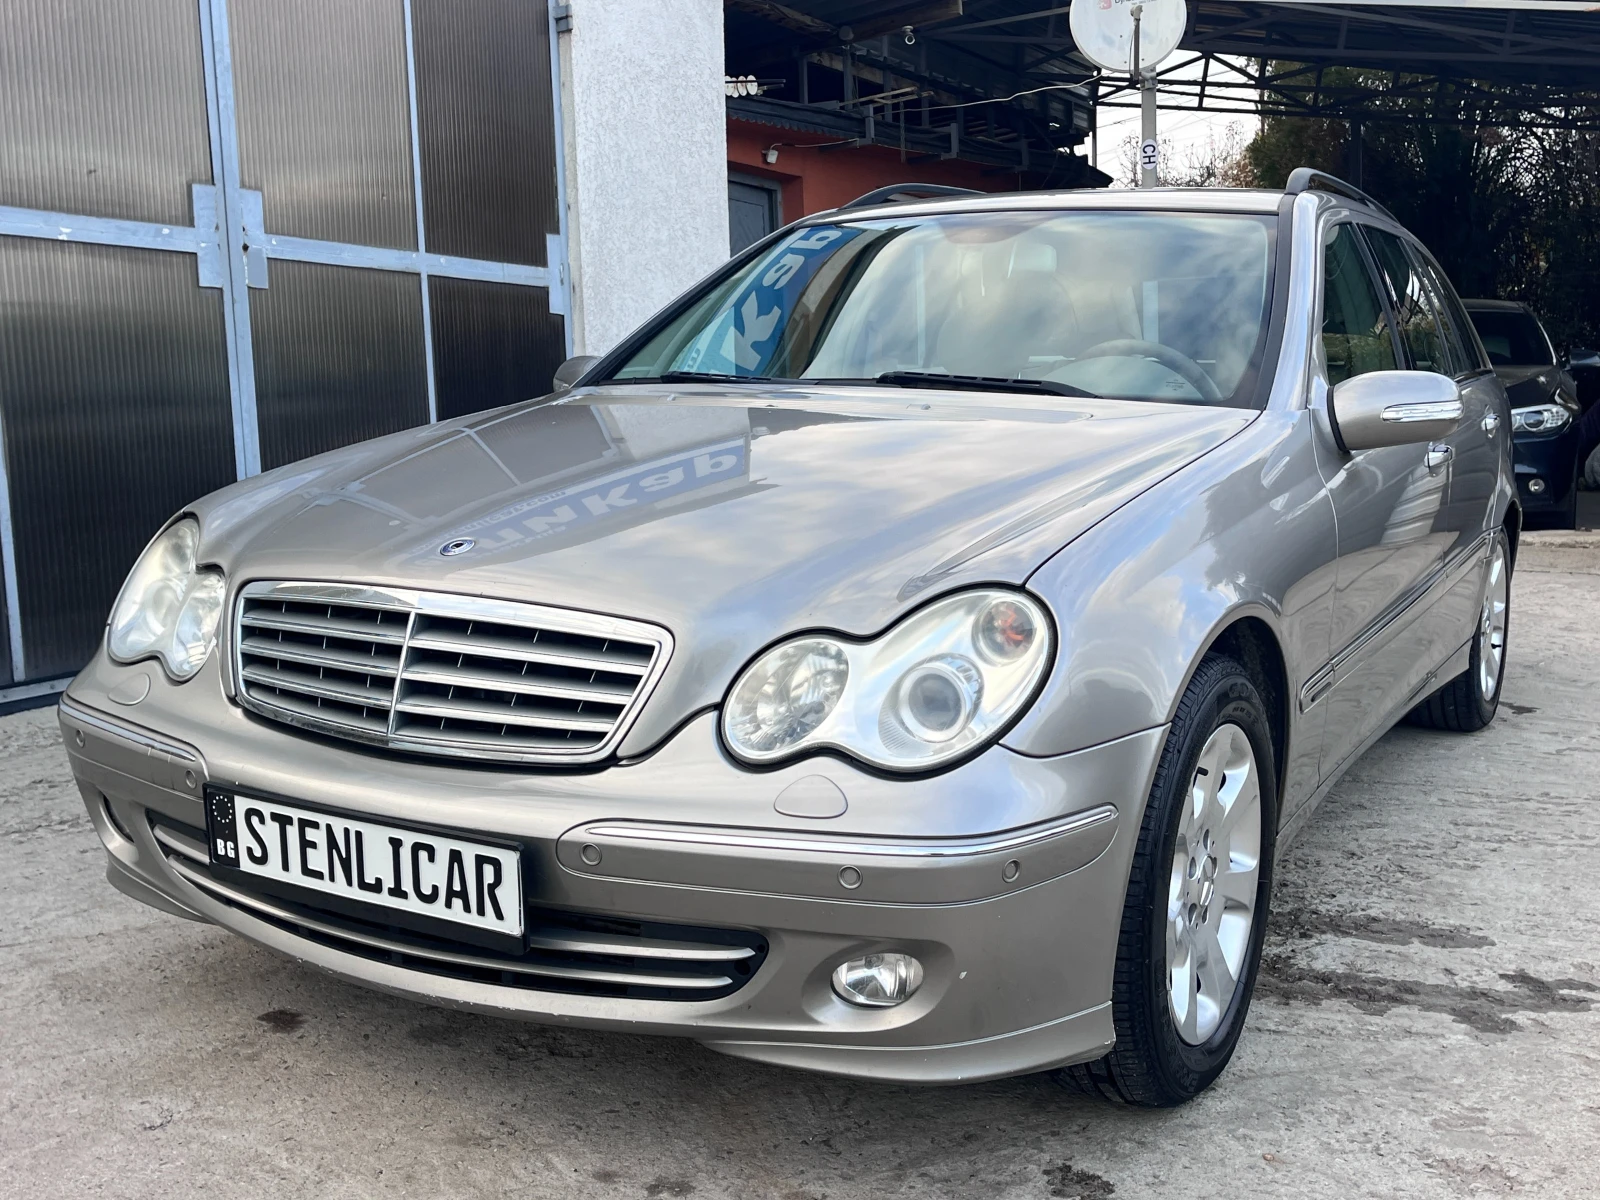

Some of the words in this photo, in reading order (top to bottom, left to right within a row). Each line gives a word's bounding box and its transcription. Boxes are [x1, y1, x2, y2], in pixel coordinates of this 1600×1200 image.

[1142, 144, 1156, 166] CH
[216, 838, 235, 858] BG
[244, 807, 505, 921] STENLICAR
